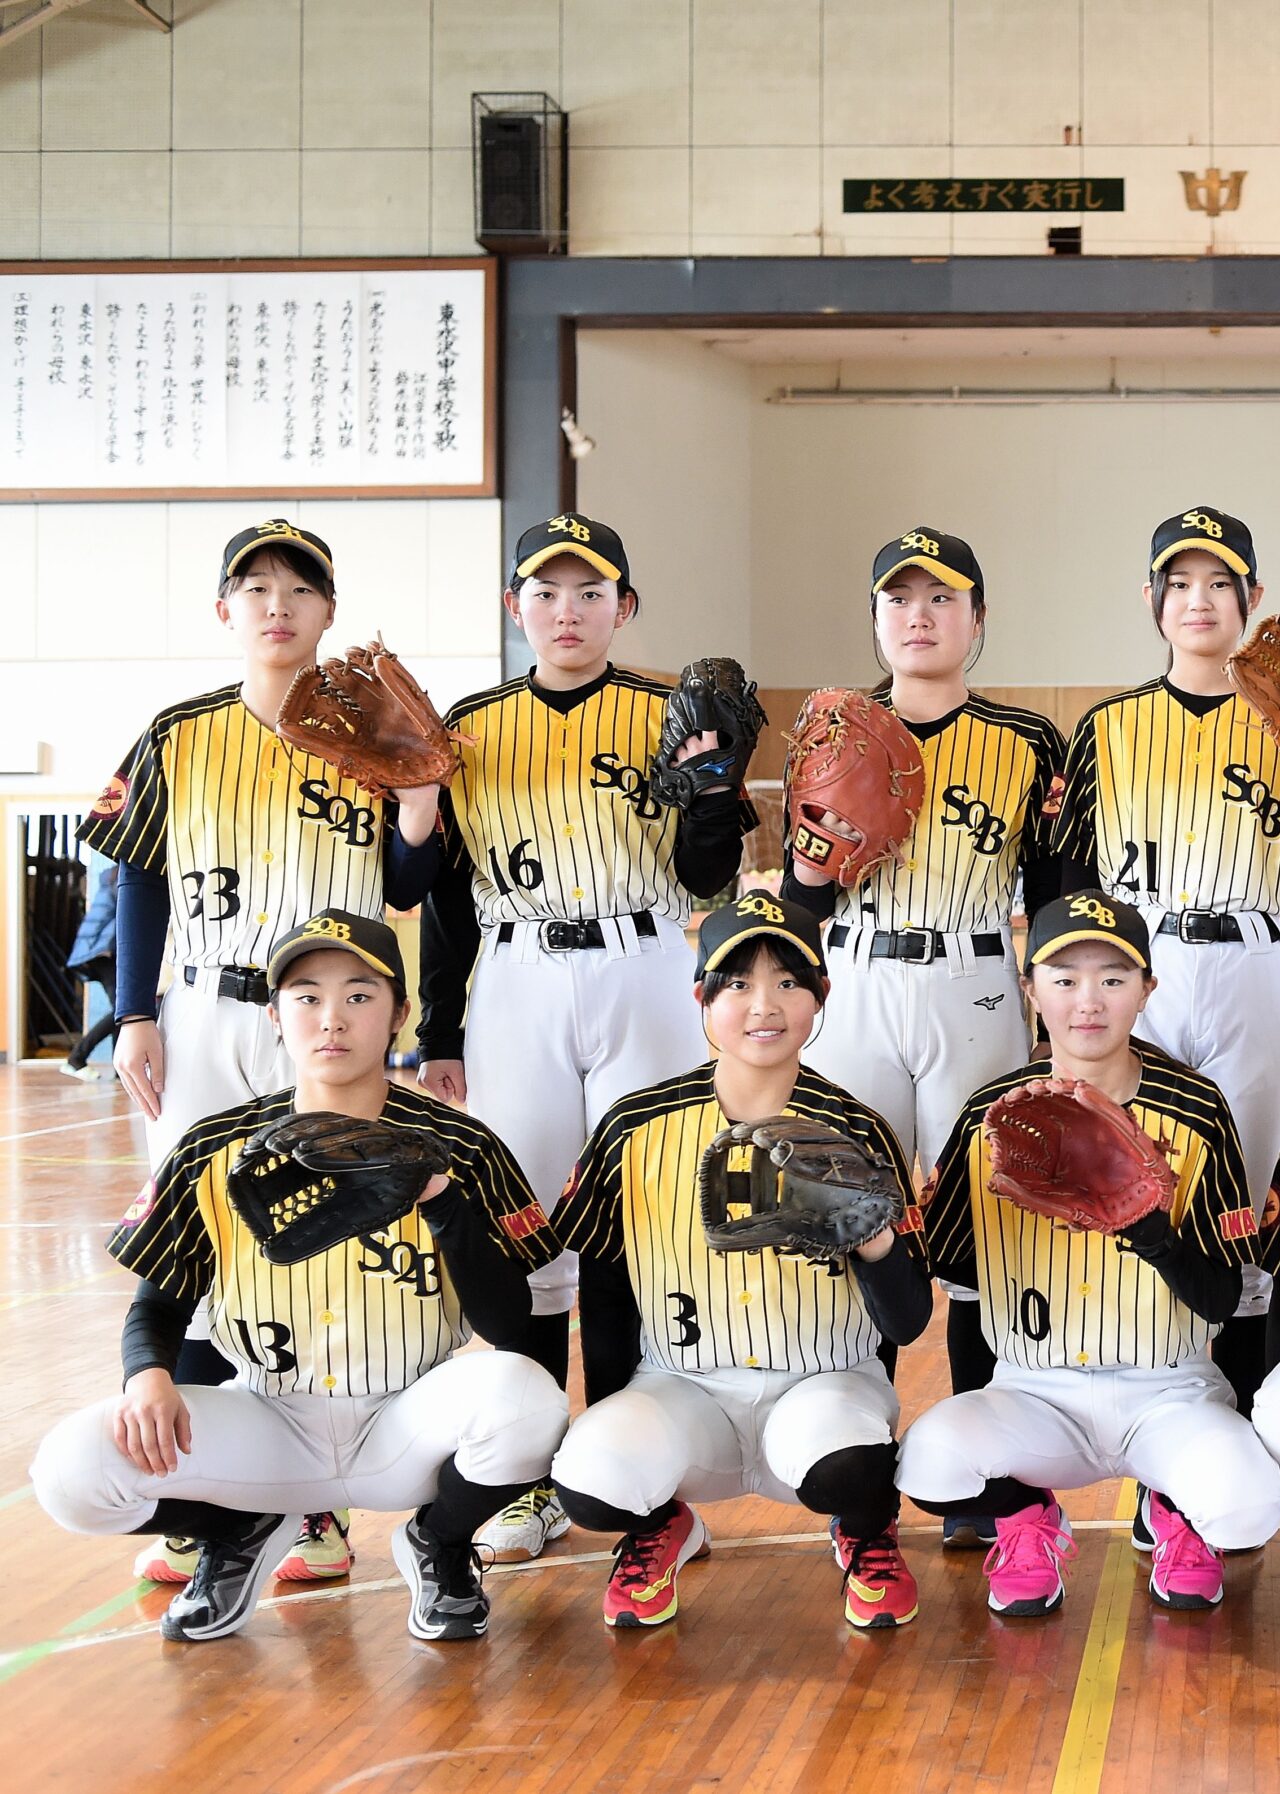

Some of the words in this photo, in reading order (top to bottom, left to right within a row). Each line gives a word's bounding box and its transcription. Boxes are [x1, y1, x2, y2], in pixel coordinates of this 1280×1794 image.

[488, 838, 544, 896] 16
[1115, 840, 1159, 892] 21
[667, 1291, 701, 1347] 3
[1010, 1277, 1051, 1341] 10
[233, 1318, 298, 1374] 13
